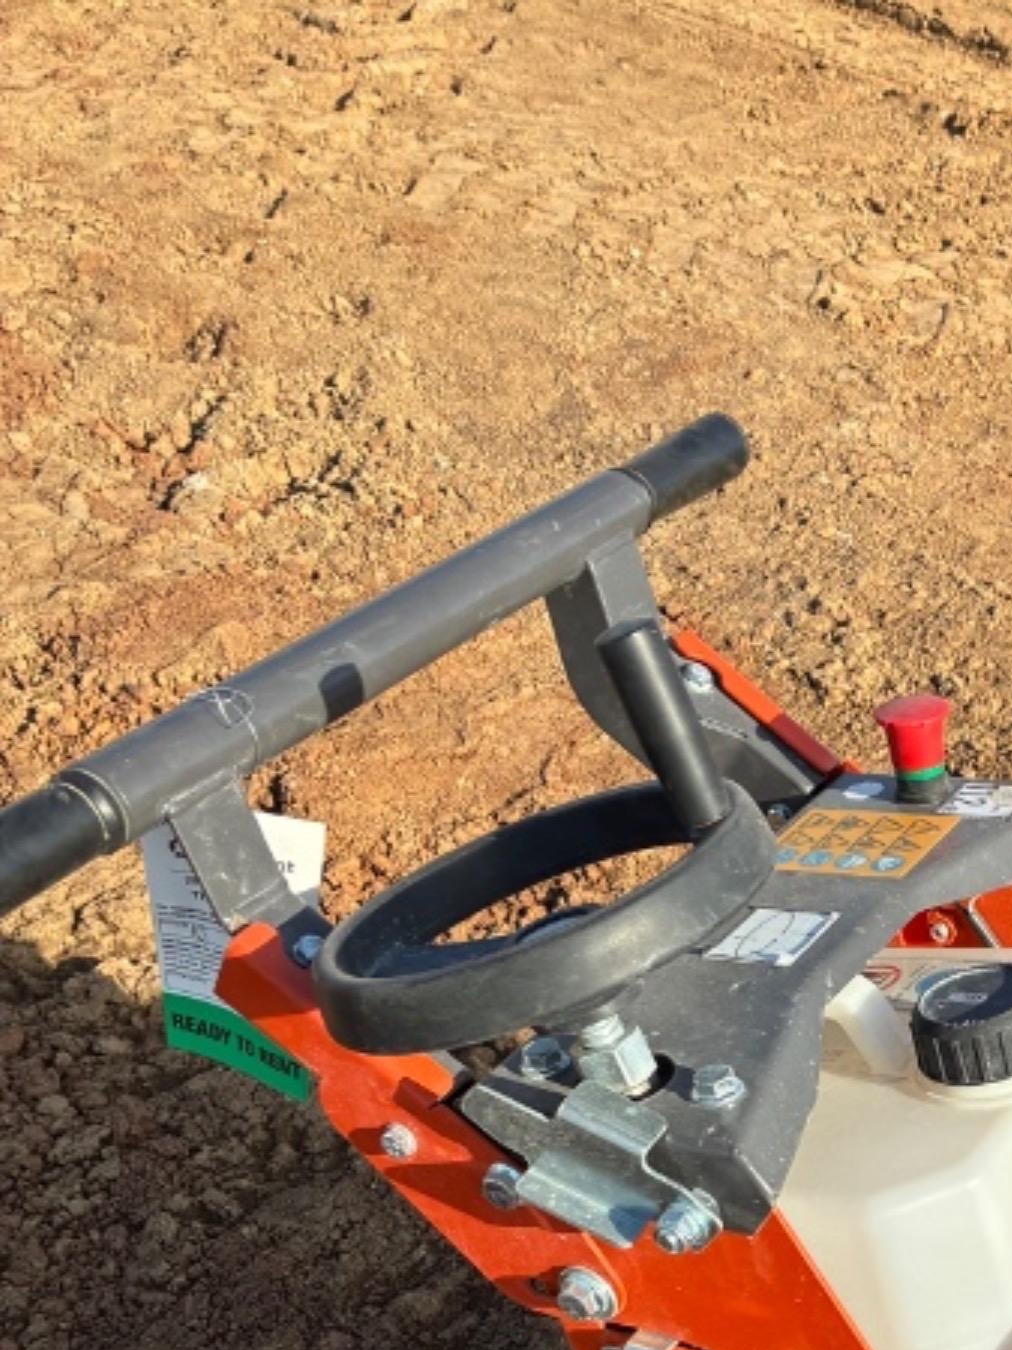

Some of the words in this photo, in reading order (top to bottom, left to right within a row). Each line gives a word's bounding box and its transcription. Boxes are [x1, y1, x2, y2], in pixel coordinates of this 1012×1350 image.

[172, 1013, 231, 1044] READY
[235, 1035, 255, 1056] TO
[258, 1046, 301, 1081] RENT
